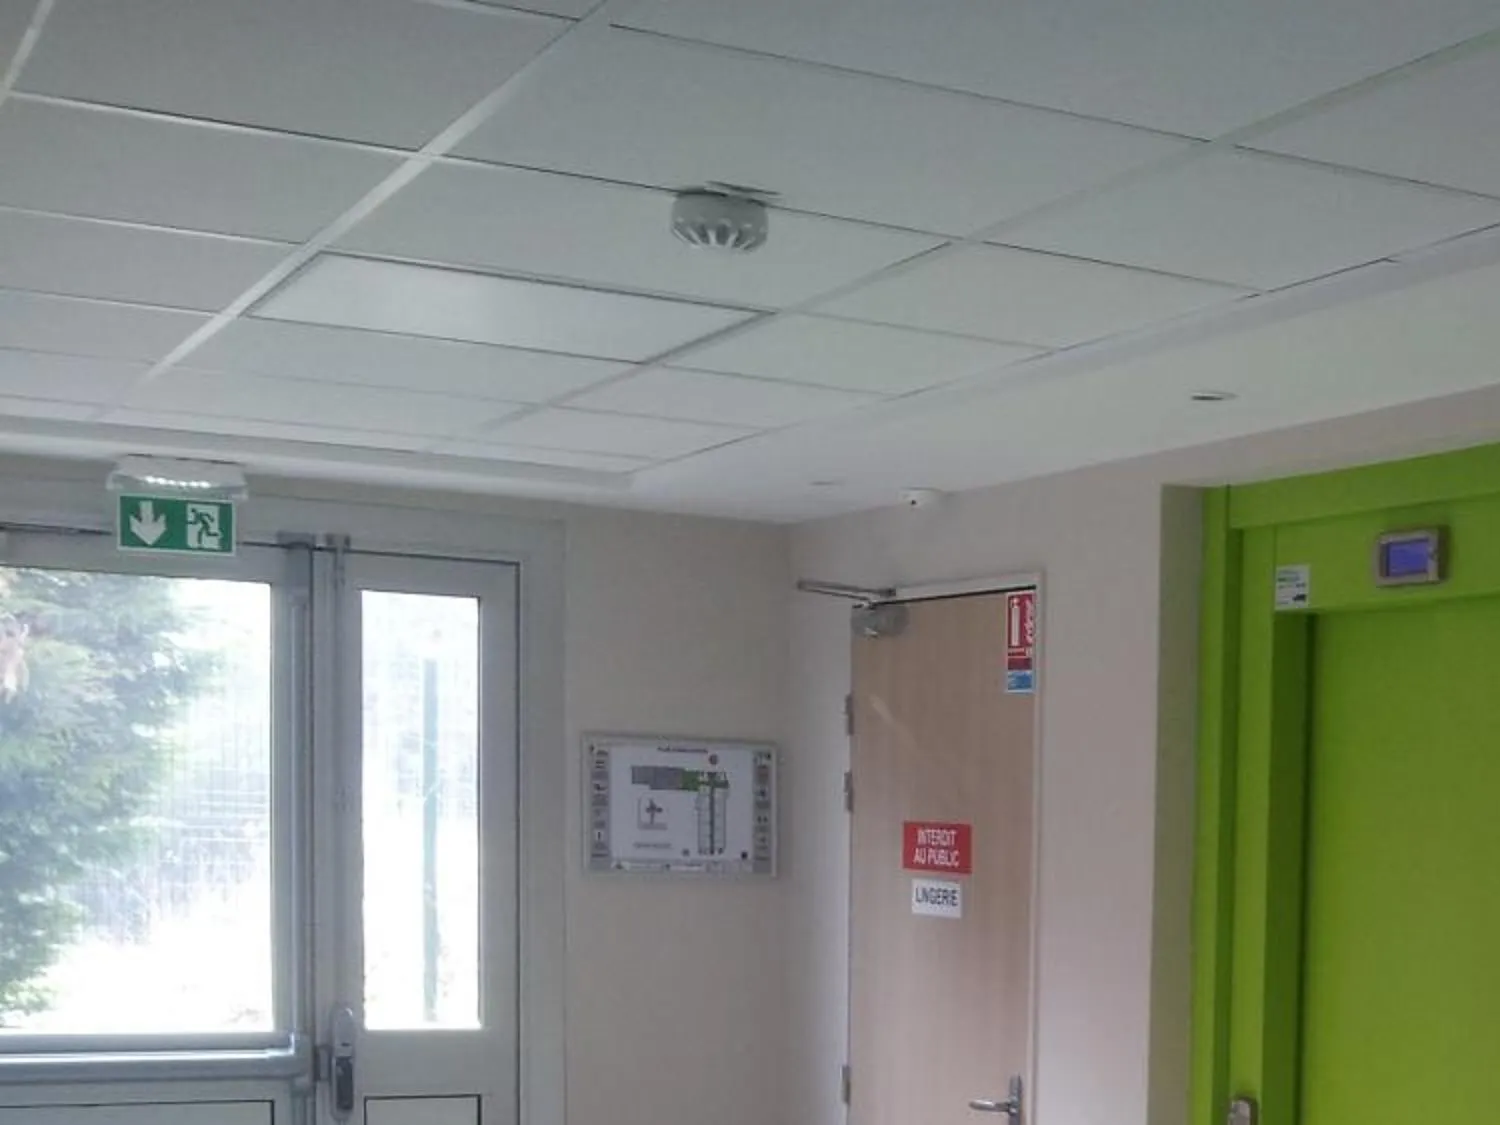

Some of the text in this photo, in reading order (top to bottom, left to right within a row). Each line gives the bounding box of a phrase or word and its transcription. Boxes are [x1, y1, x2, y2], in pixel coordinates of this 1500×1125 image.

[917, 829, 957, 847] INTERDIT
[913, 847, 960, 868] AU PUBLIC
